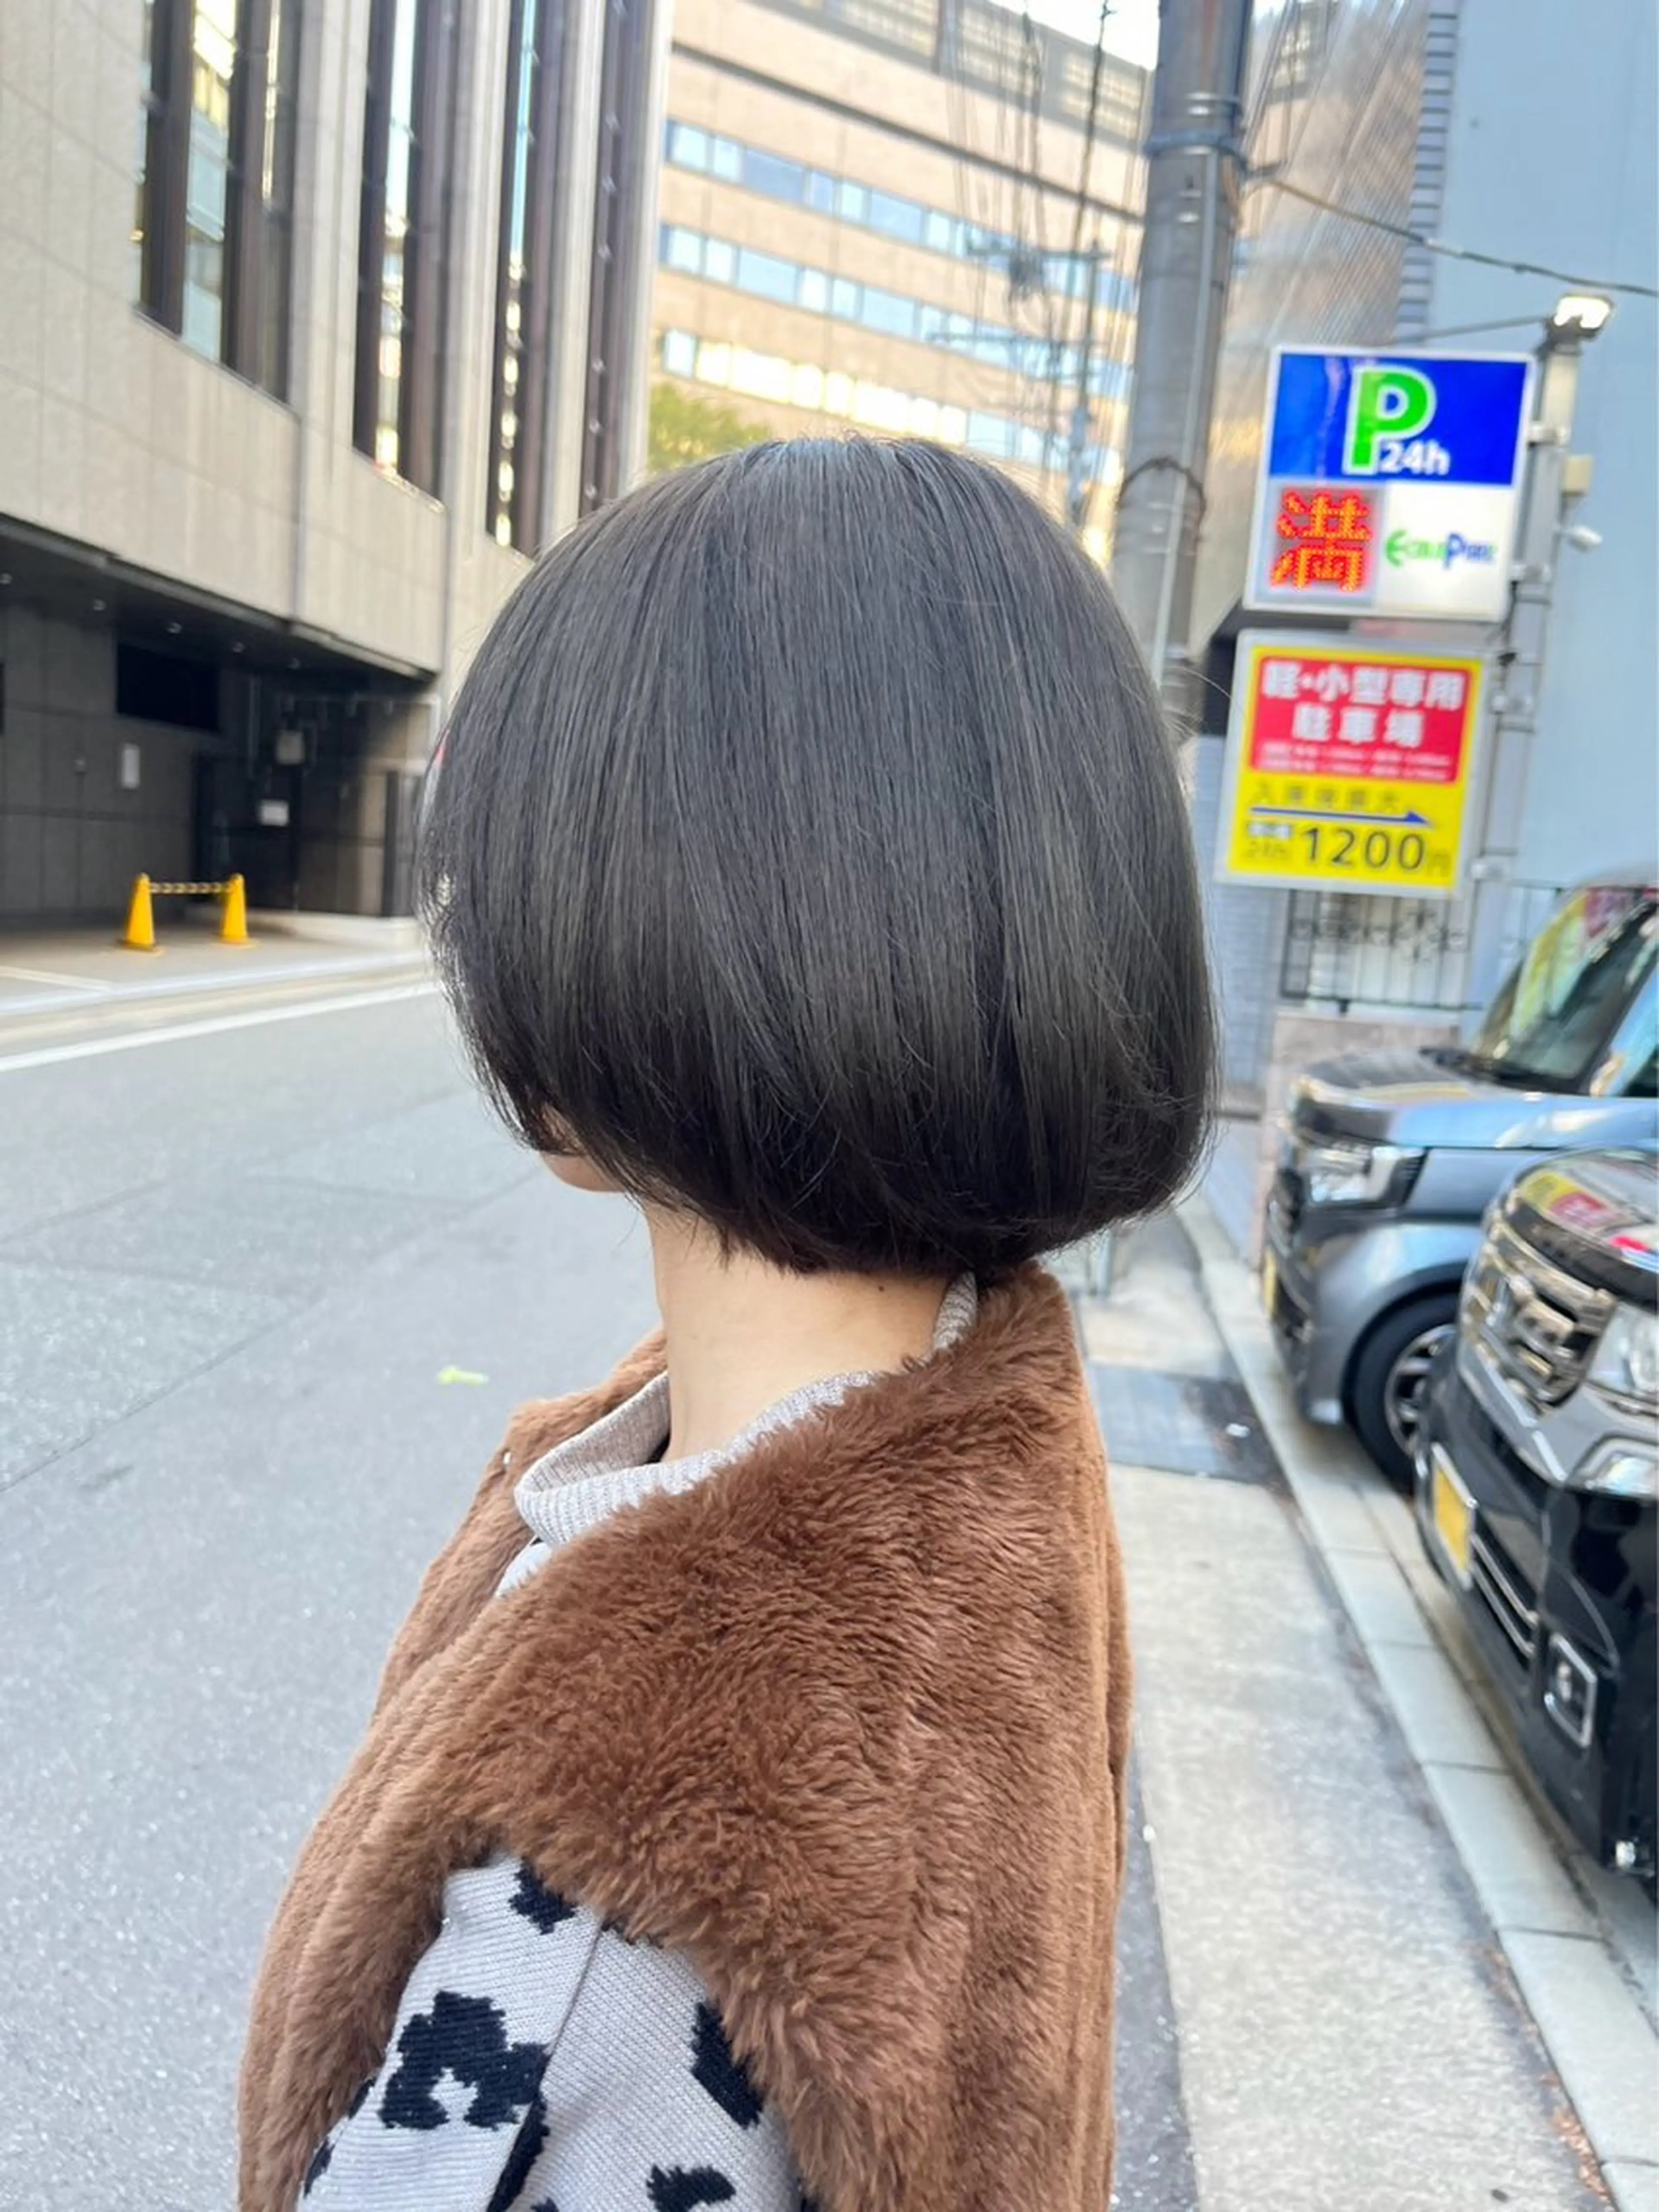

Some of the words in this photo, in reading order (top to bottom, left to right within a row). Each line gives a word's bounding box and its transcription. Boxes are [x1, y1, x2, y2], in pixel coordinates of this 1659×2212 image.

[1343, 366, 1437, 474] P
[1379, 440, 1450, 475] 24h
[1271, 489, 1372, 591] 満
[1292, 702, 1425, 748] 駐車場
